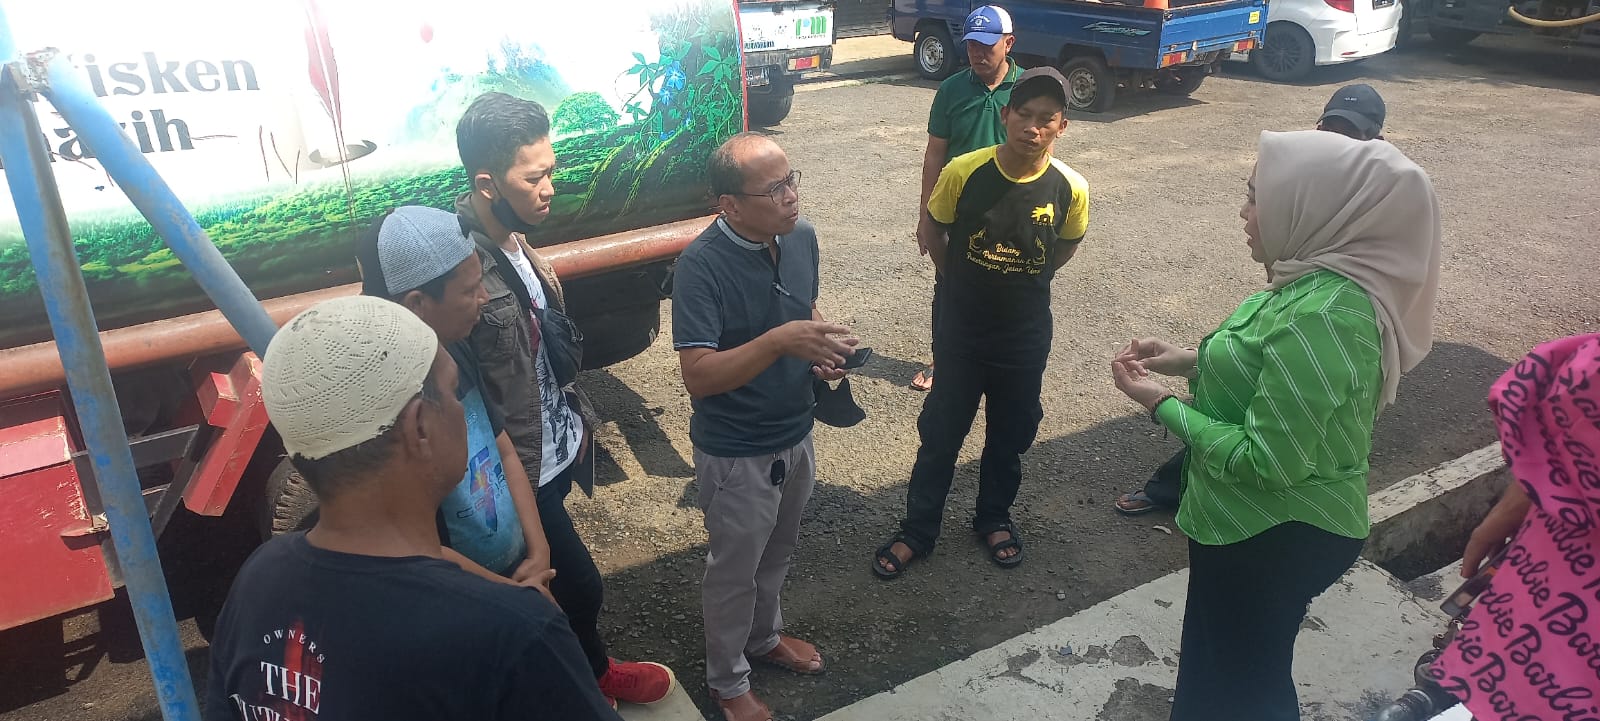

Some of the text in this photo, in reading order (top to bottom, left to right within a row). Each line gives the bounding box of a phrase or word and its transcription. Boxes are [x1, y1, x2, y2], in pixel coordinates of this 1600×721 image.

[67, 51, 260, 98] isken
[995, 243, 1021, 257] Bidang
[1503, 545, 1550, 608] arbie
[1478, 583, 1514, 638] rbie
[263, 629, 325, 664] OWNERS
[1454, 620, 1483, 664] bie
[260, 661, 321, 714] THE
[1503, 623, 1600, 721] Barbi
